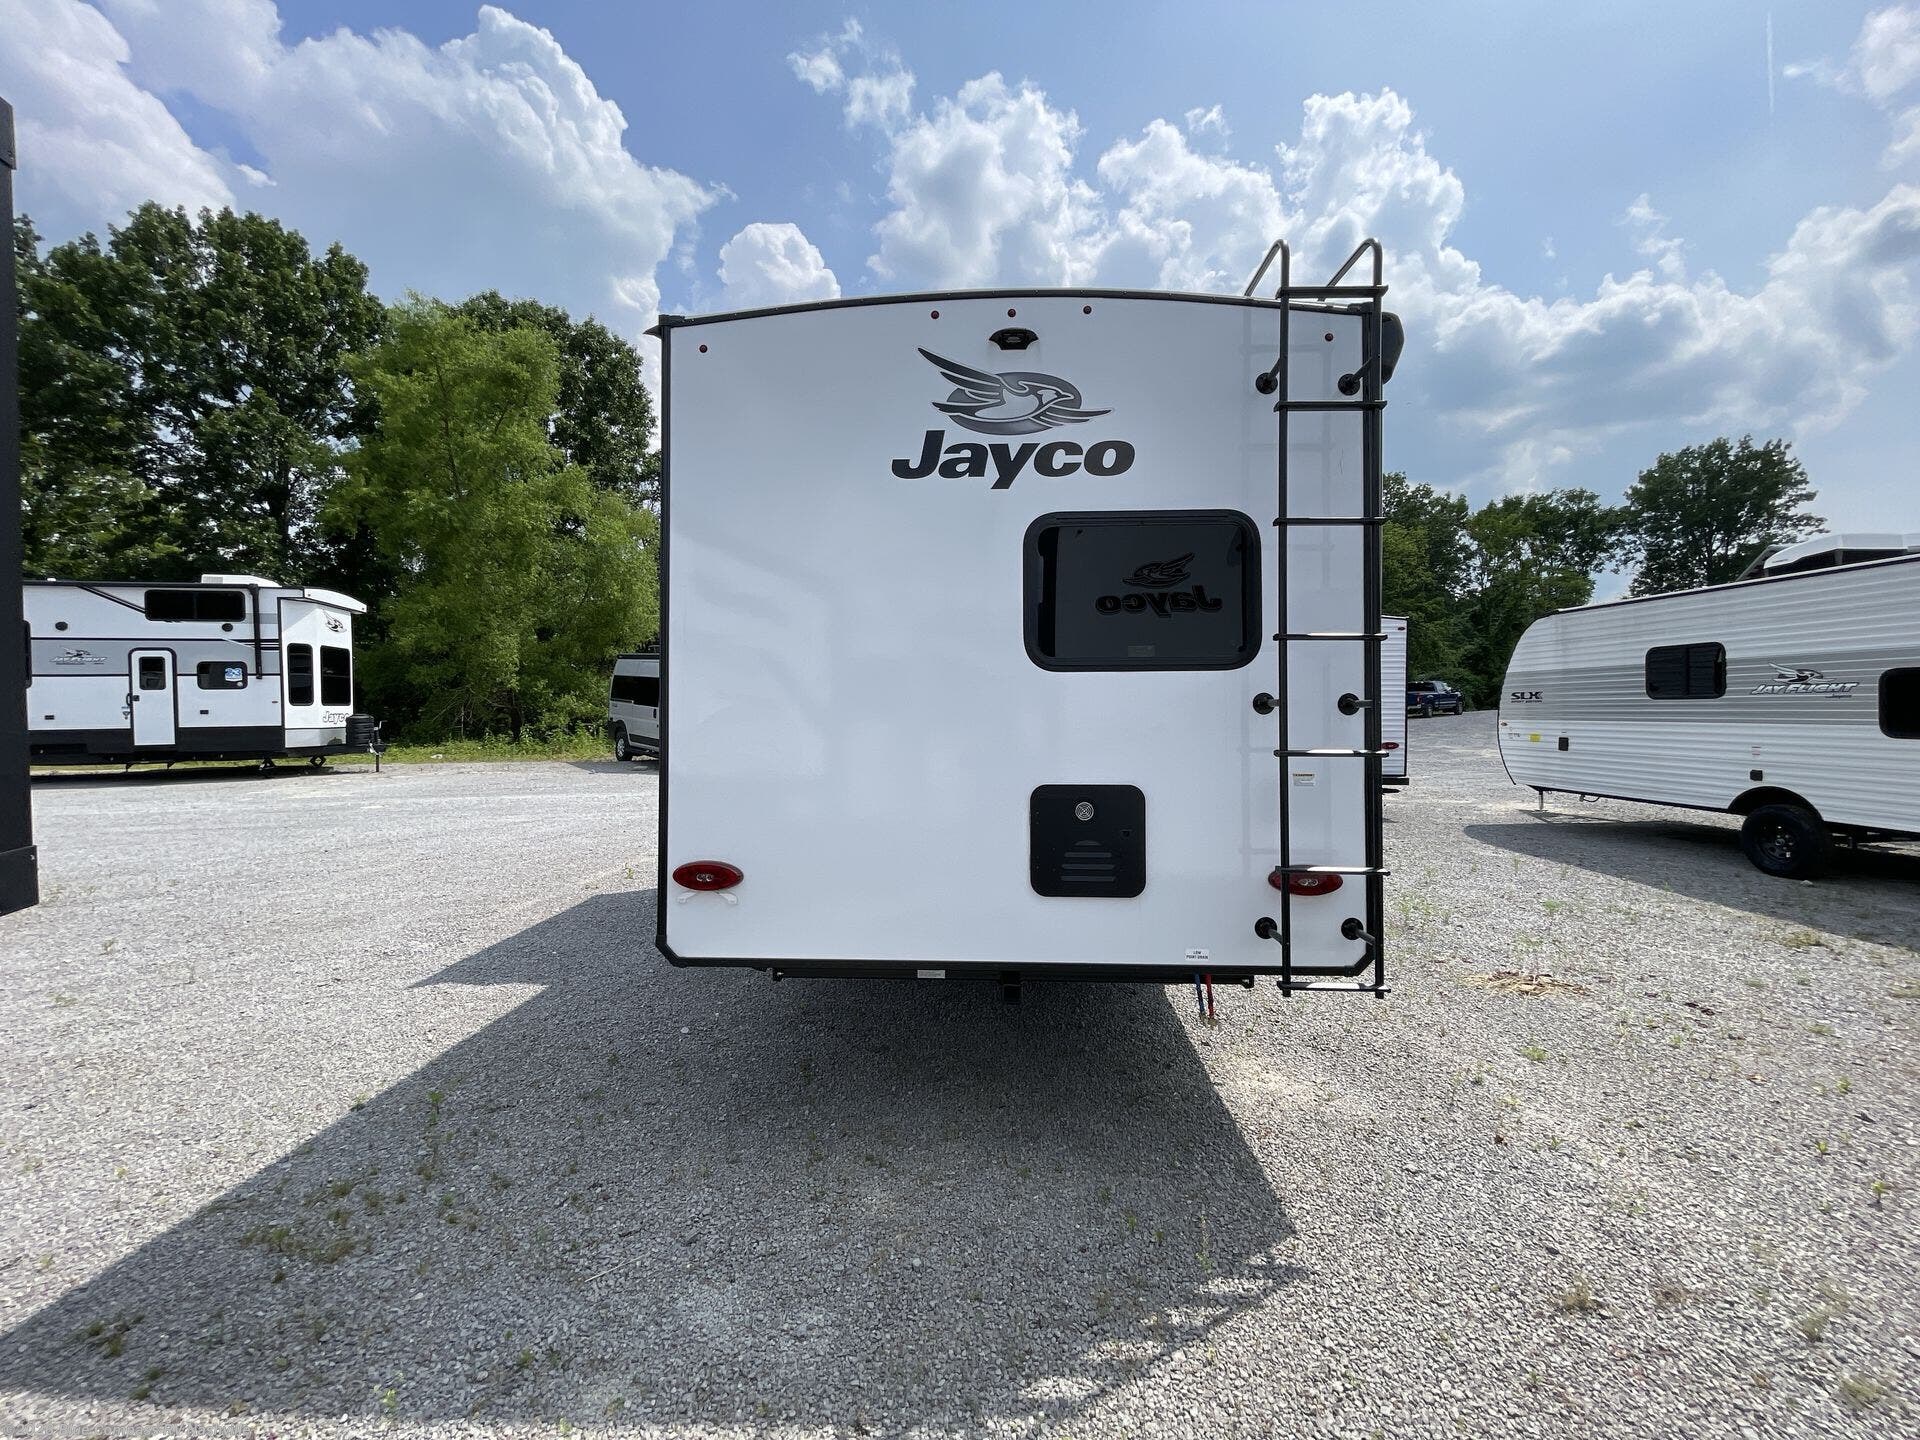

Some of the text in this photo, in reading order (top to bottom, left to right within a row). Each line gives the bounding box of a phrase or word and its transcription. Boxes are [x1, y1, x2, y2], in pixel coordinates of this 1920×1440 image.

[891, 430, 1135, 489] Jayco
[1751, 682, 1860, 695] JAY FLIGHT
[1511, 691, 1543, 700] SLX
